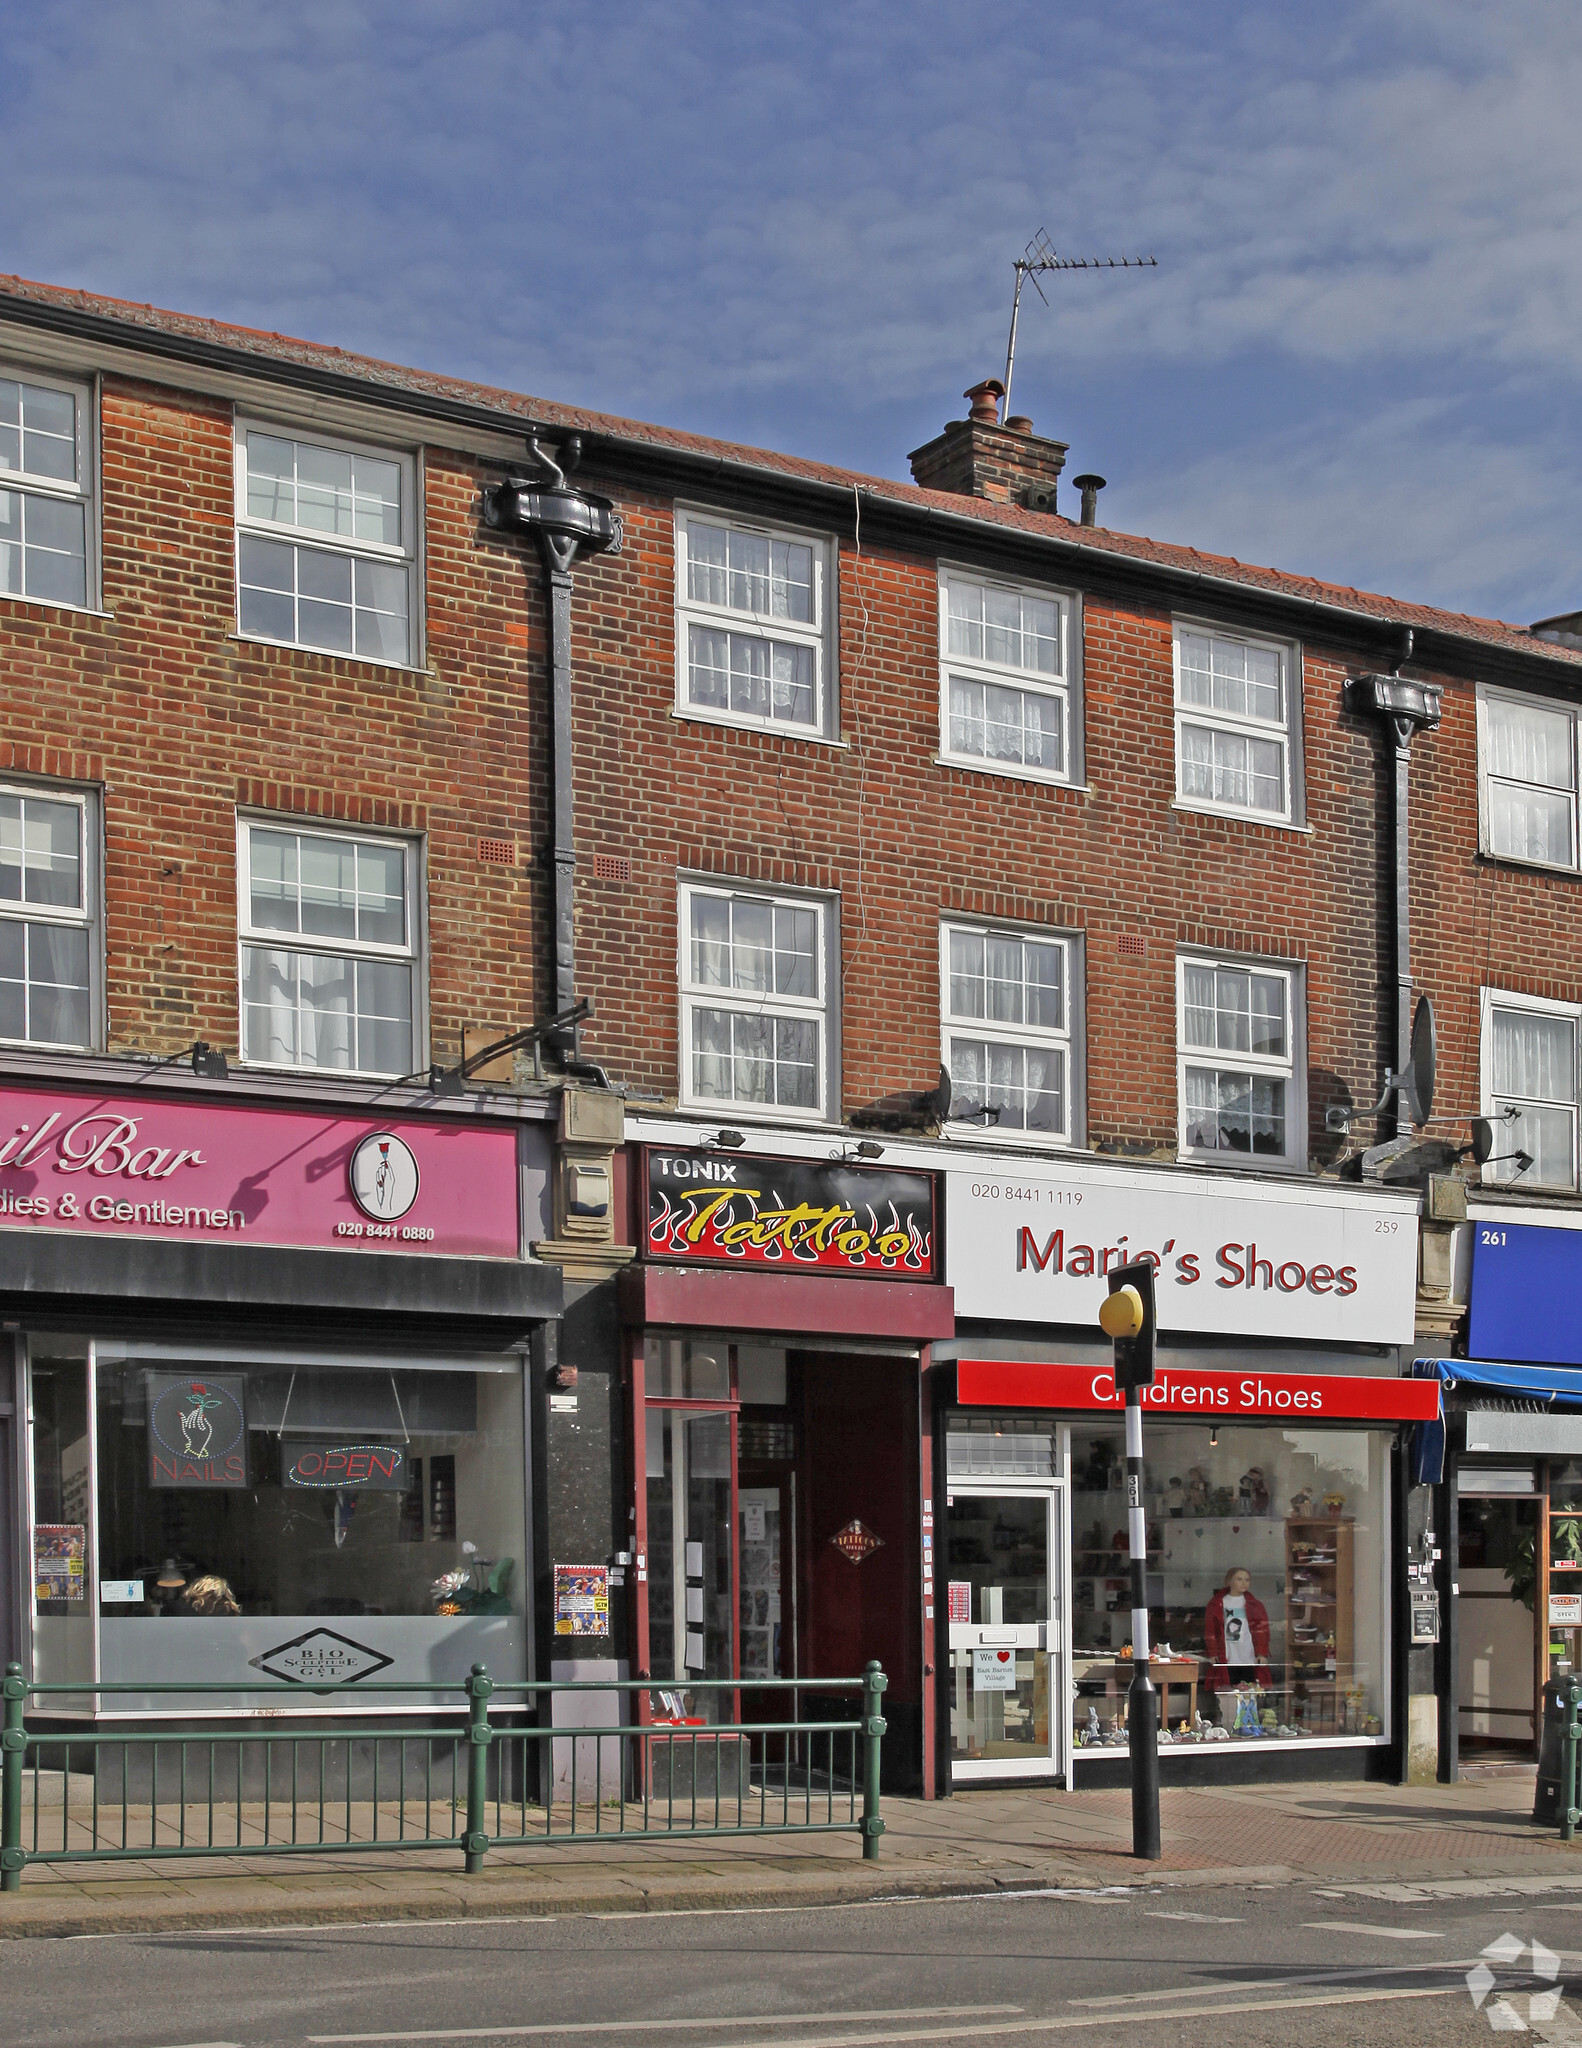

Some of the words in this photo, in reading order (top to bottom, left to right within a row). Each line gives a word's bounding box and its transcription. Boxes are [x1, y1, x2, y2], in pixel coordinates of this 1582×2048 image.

[58, 1113, 207, 1177] Bar
[657, 1158, 737, 1182] TONIX
[971, 1184, 1000, 1198] 020
[1005, 1187, 1039, 1201] 8441
[1048, 1191, 1082, 1205] 1119
[59, 1193, 81, 1218] &
[90, 1195, 246, 1228] Gentlemen
[680, 1187, 910, 1258] Tattoo
[337, 1222, 363, 1236] 020
[366, 1224, 398, 1238] 8441
[402, 1226, 435, 1240] 0880
[1374, 1221, 1399, 1234] 259
[1481, 1231, 1507, 1246] 261
[1217, 1243, 1358, 1295] Shoes
[1240, 1380, 1323, 1409] Shoes
[297, 1453, 396, 1477] OPEN
[1128, 1476, 1137, 1505] 361
[980, 1653, 993, 1661] We
